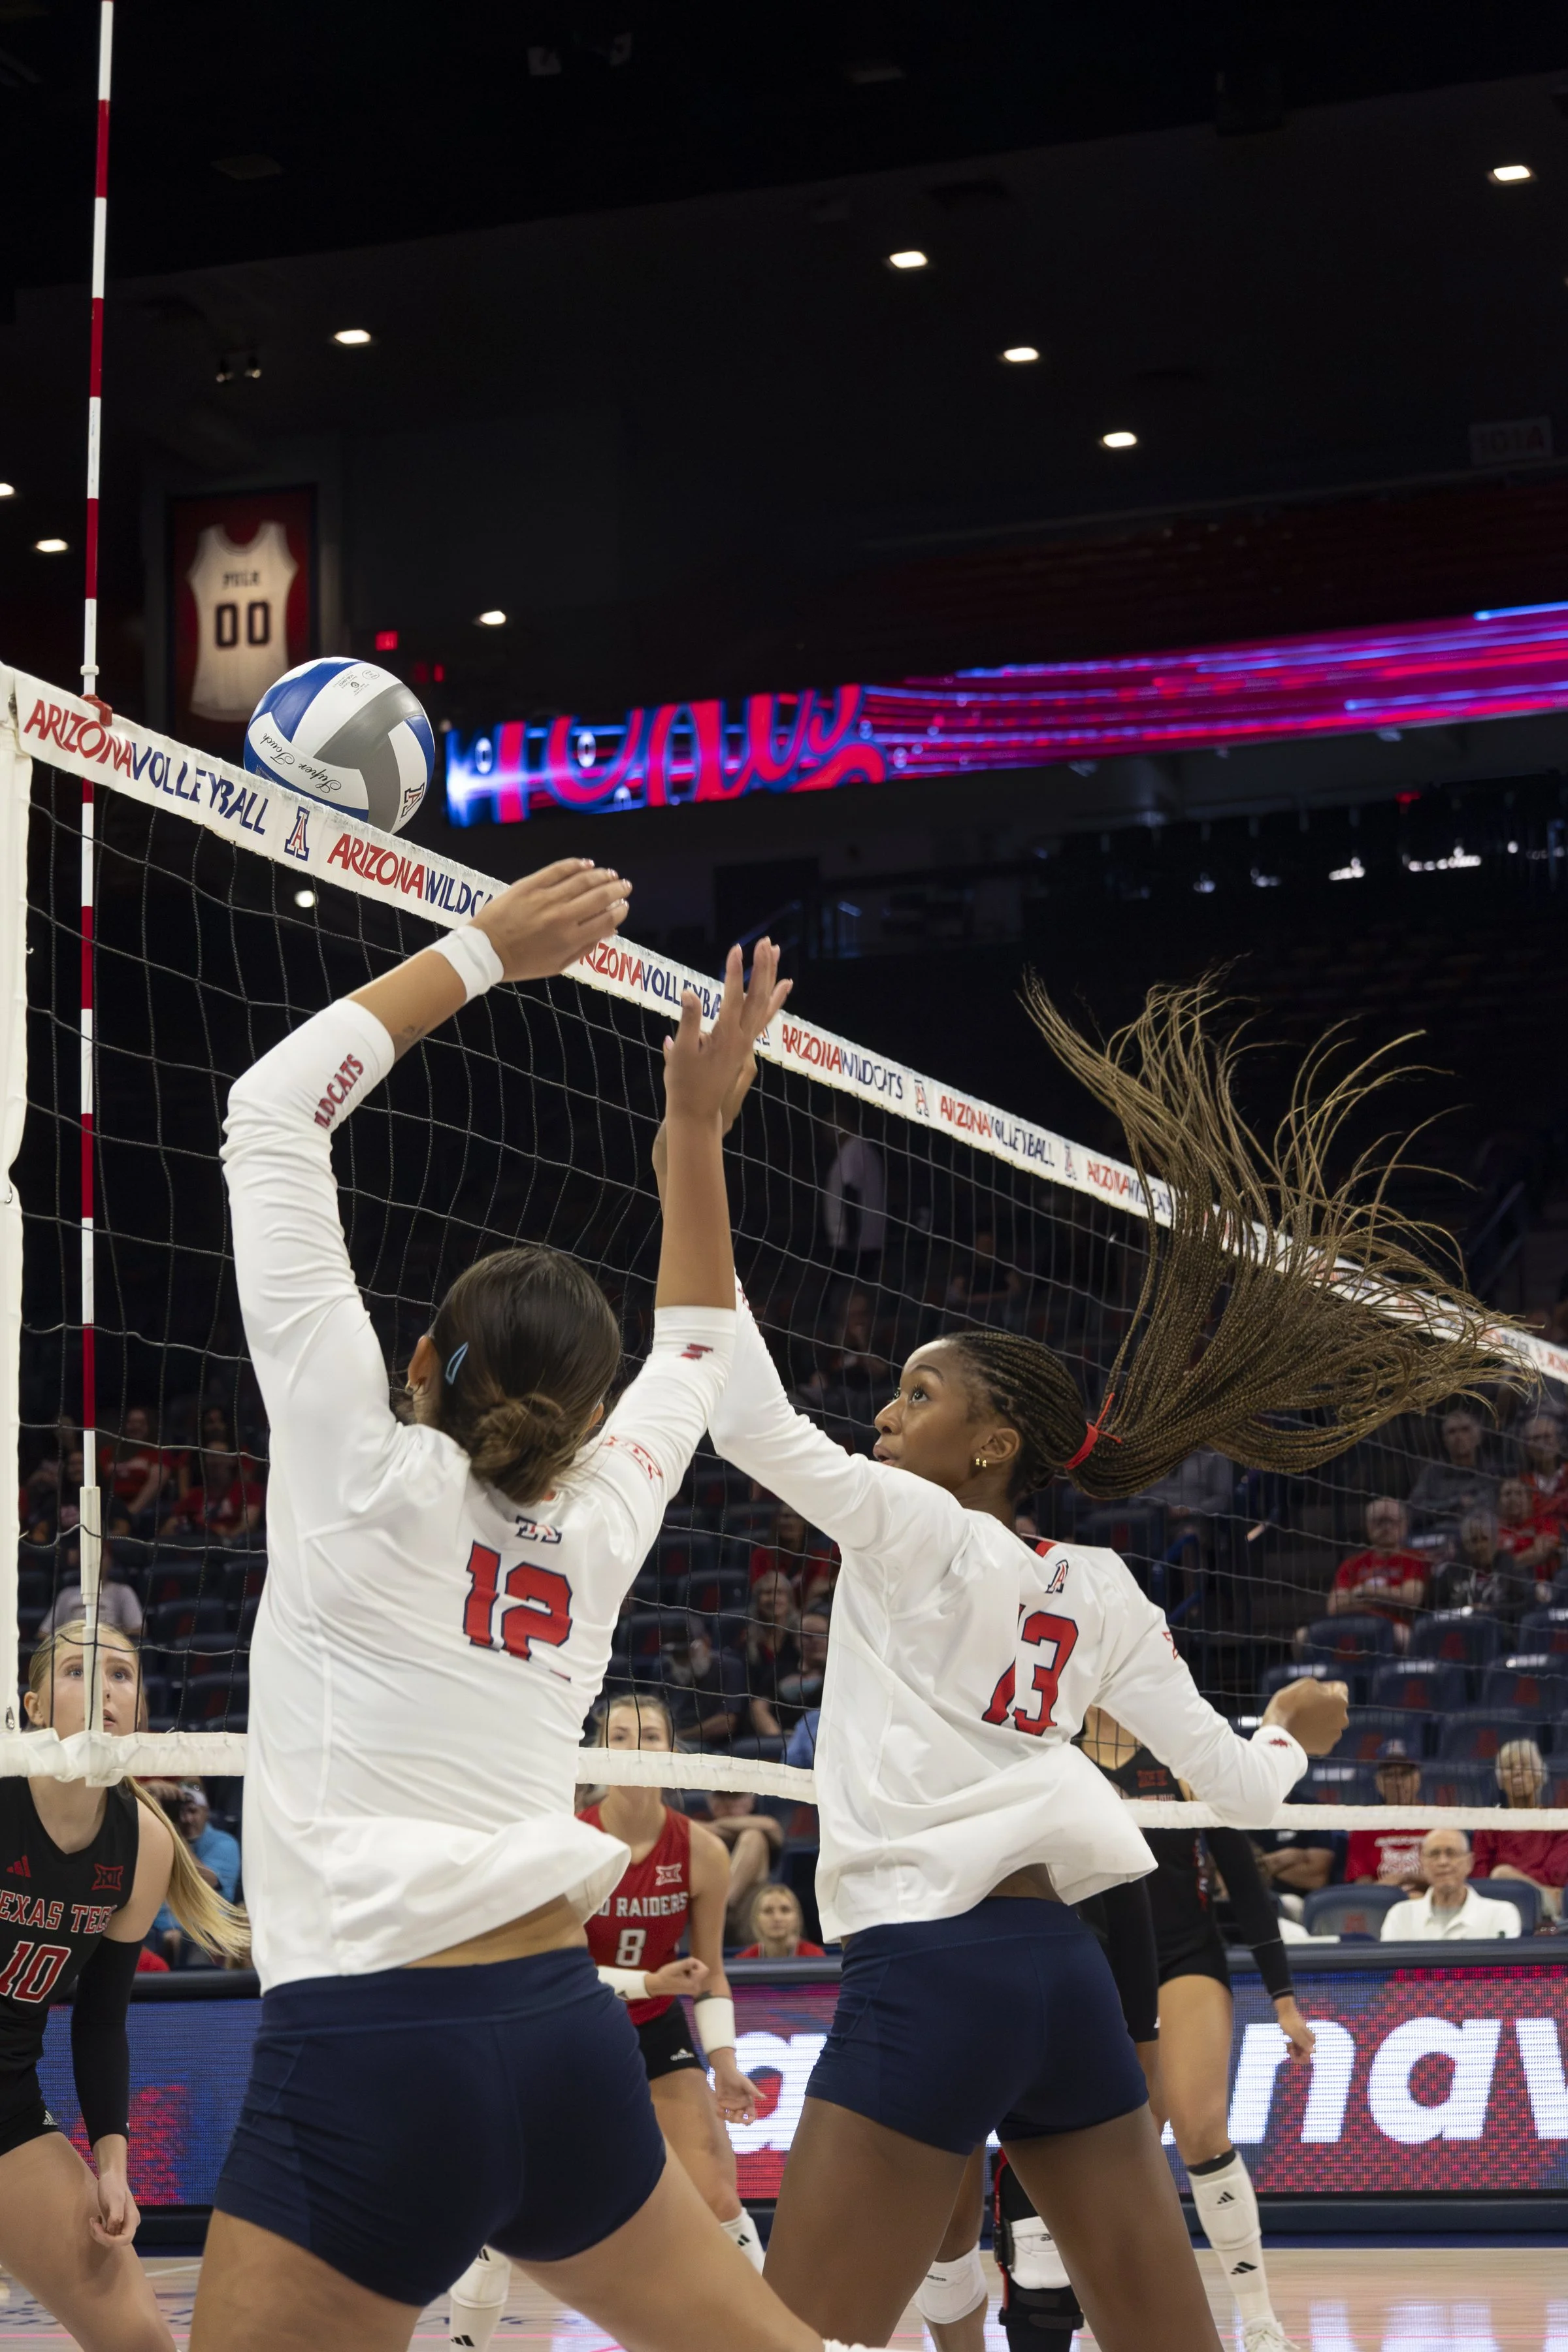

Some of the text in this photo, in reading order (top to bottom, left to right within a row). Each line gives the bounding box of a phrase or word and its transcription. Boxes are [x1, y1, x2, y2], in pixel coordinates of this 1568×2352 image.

[215, 601, 270, 648] 00
[259, 732, 342, 800] Super Touch
[463, 1539, 573, 1662] 12
[0, 1889, 118, 1934] EXAS TEC
[616, 1892, 689, 1917] RAIDERS
[0, 1940, 71, 2003] 10
[615, 1929, 646, 1967] 8
